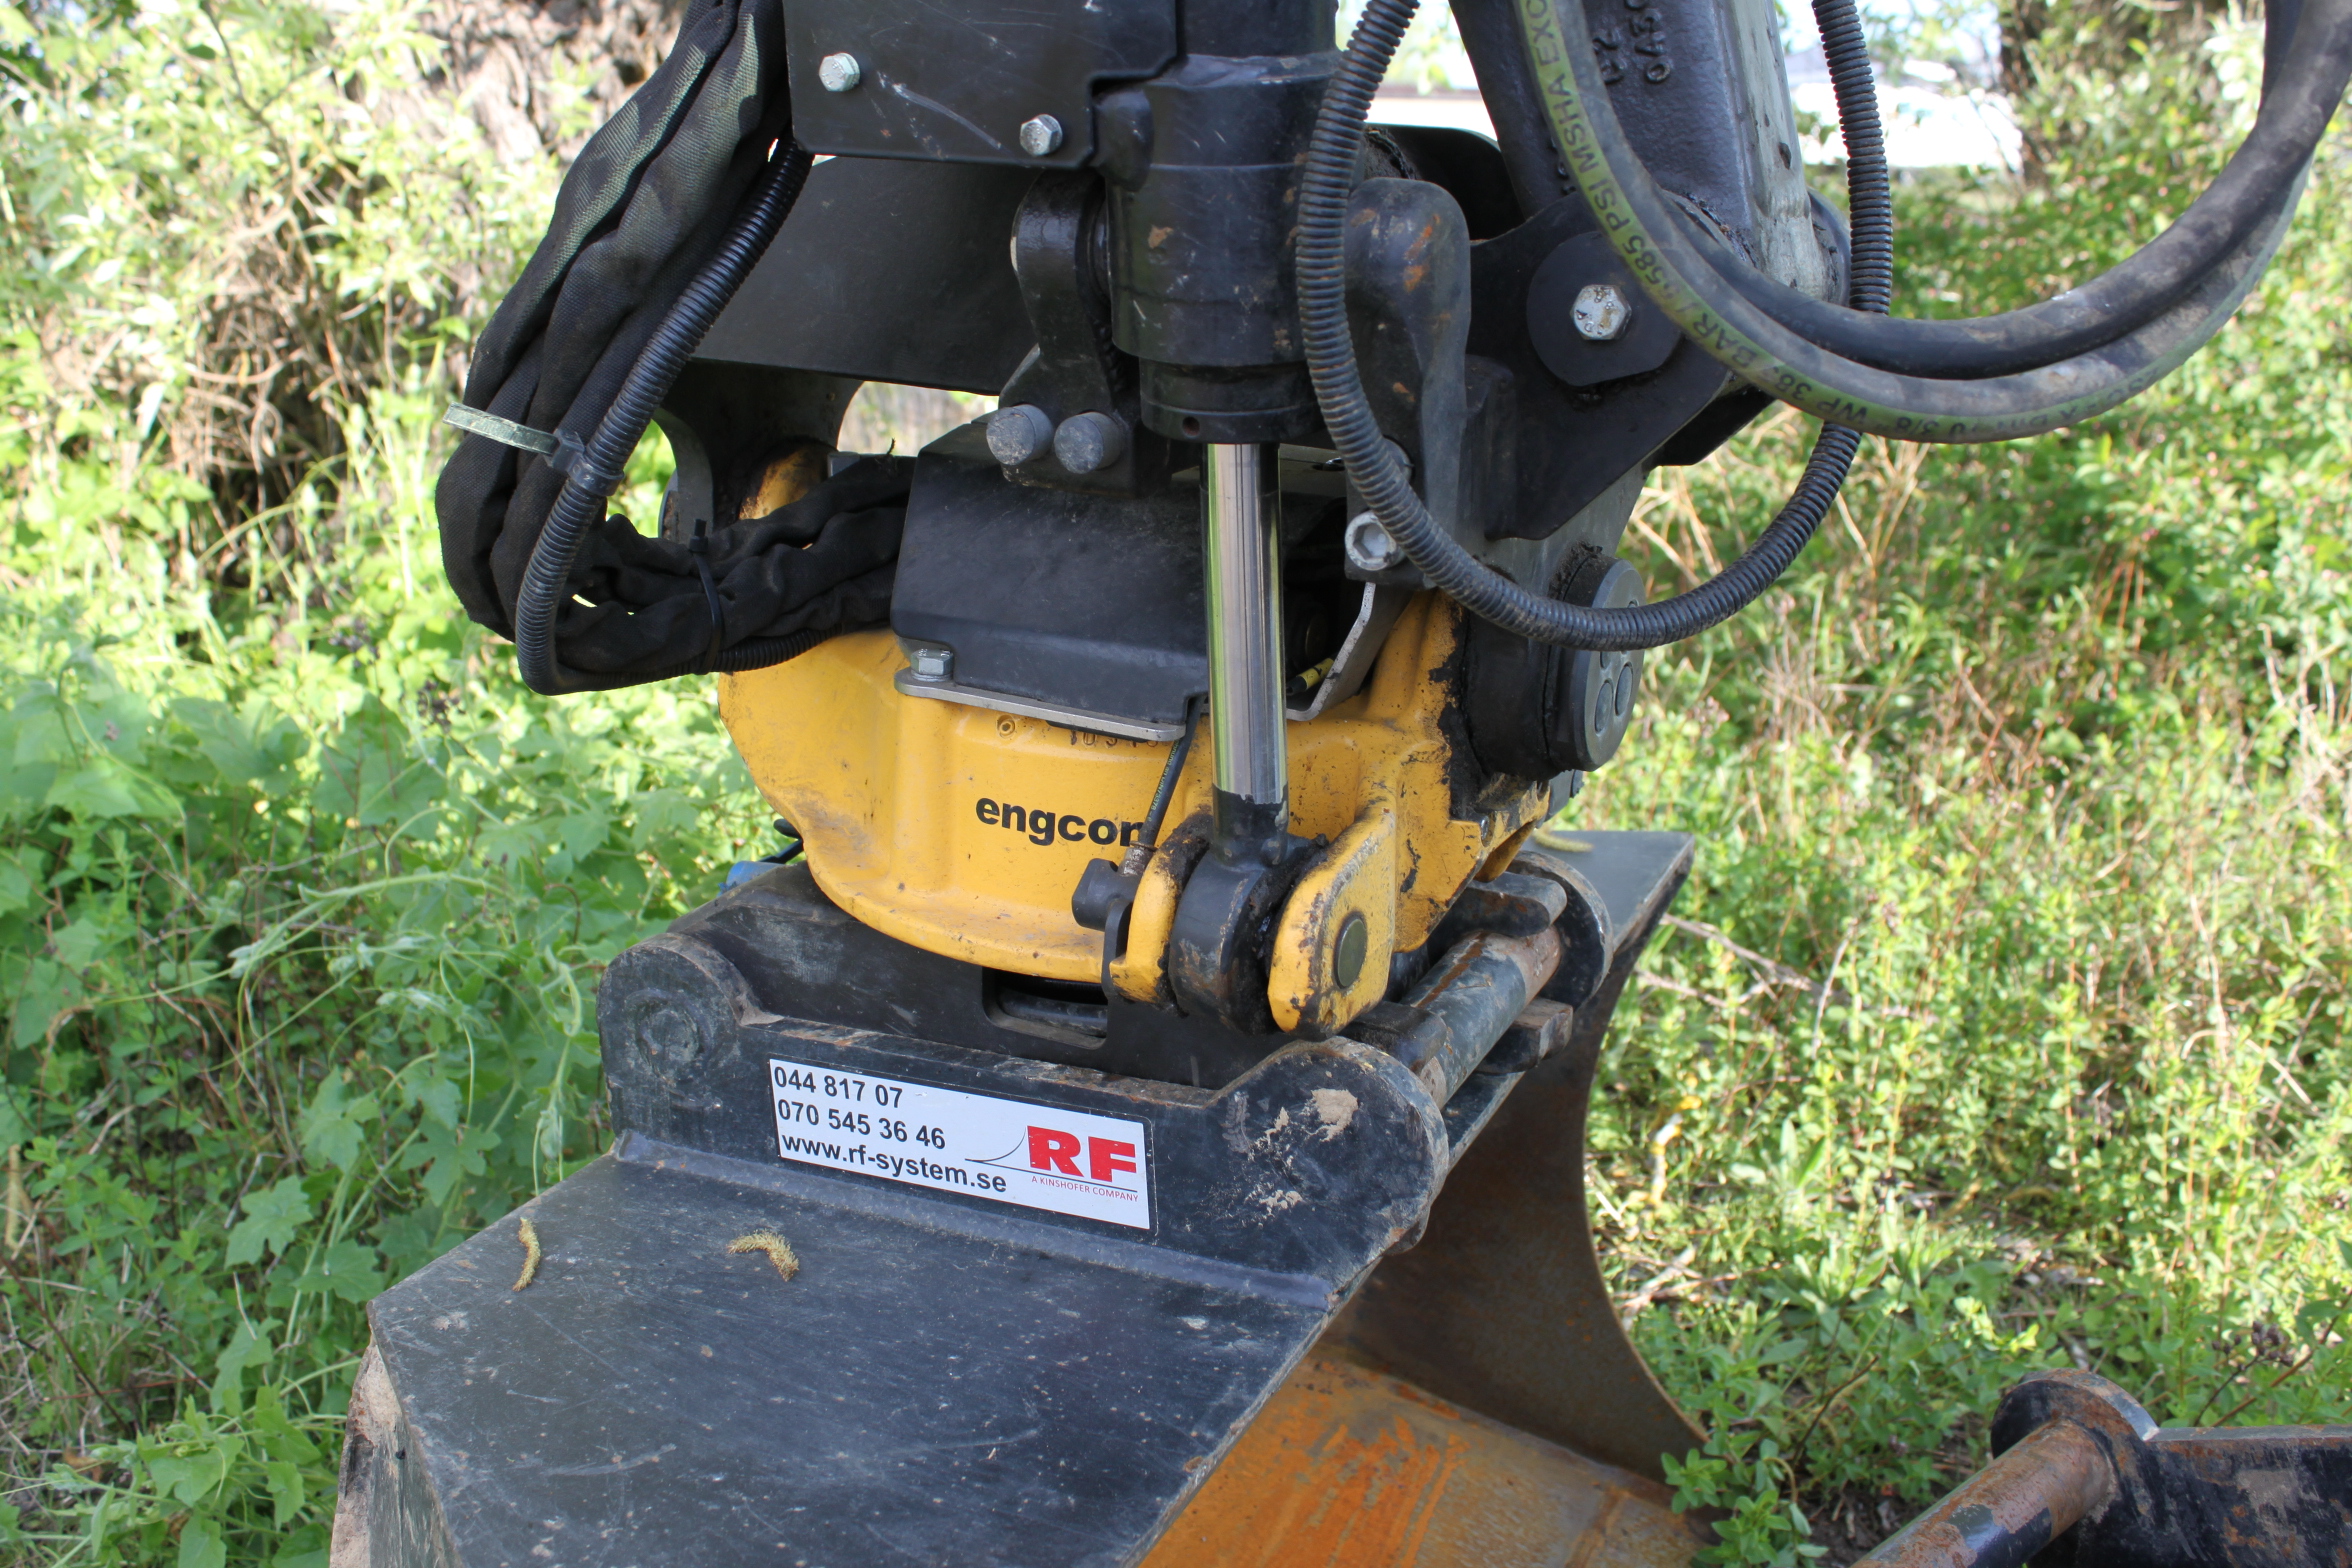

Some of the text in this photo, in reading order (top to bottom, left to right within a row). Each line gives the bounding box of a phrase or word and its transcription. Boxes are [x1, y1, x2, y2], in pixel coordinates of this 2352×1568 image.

[1547, 73, 1599, 174] MSHA
[1588, 178, 1630, 232] PSI
[1693, 312, 1758, 368] BAR
[1816, 397, 1868, 425] WP
[774, 1066, 903, 1108] 044 817 07
[778, 1099, 946, 1149] 070 545 36 46
[782, 1134, 1007, 1193] www.rf-system.se
[1027, 1125, 1137, 1182] RF
[1031, 1175, 1139, 1202] A KINSHOFER COMPANY
